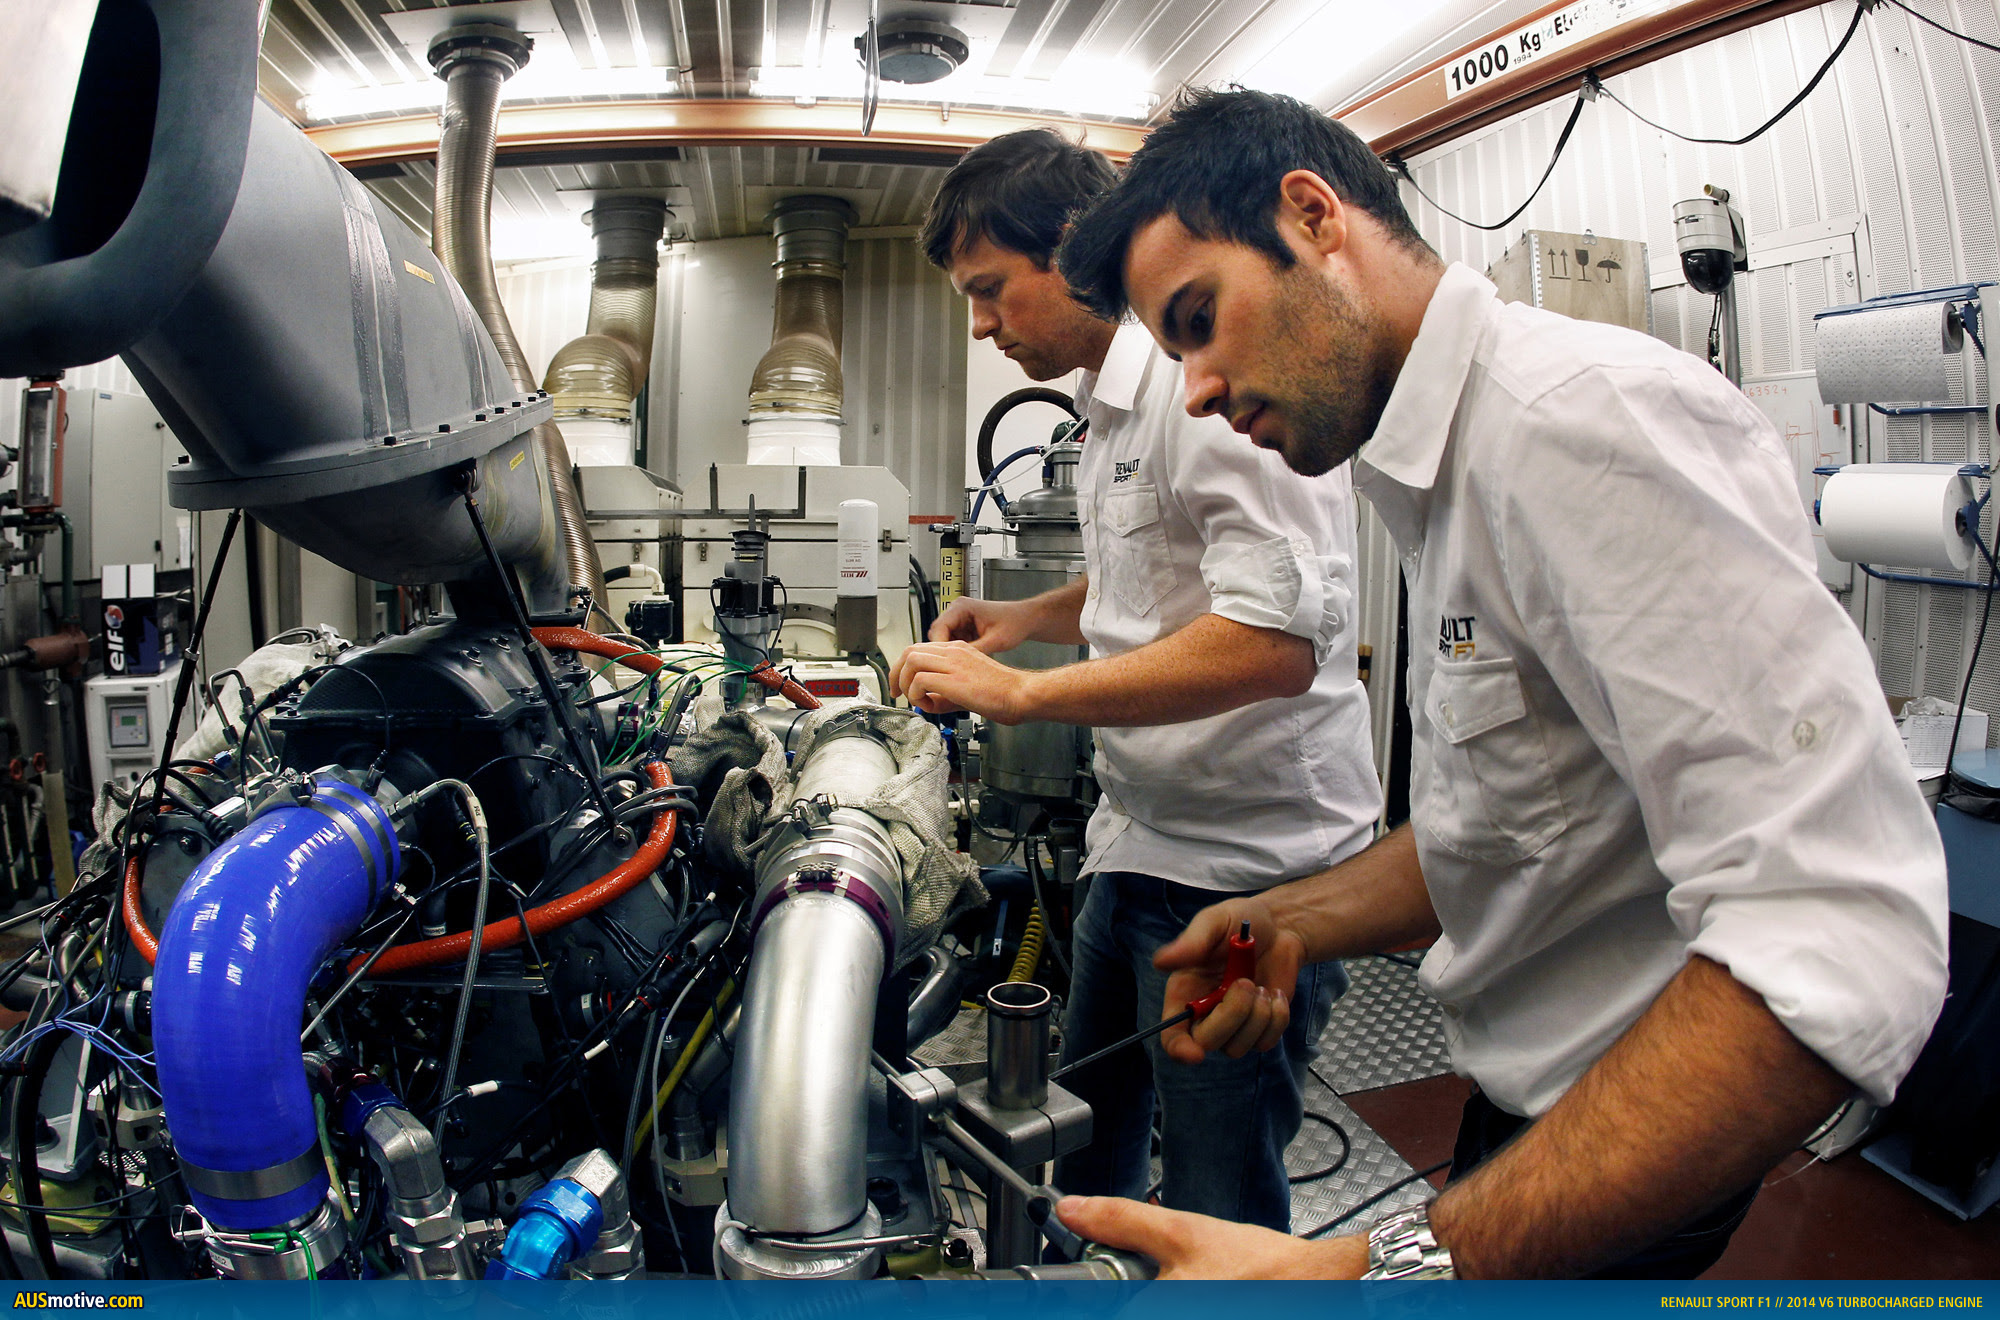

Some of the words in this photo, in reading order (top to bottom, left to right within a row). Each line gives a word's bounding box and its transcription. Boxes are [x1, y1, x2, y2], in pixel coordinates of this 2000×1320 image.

[1451, 44, 1509, 91] 1000
[1519, 32, 1541, 52] Kg
[1513, 52, 1532, 65] 1994
[942, 556, 952, 566] 13
[942, 571, 952, 581] 12
[942, 586, 950, 596] 11
[107, 629, 125, 671] elf
[808, 683, 855, 692] LUFKIN
